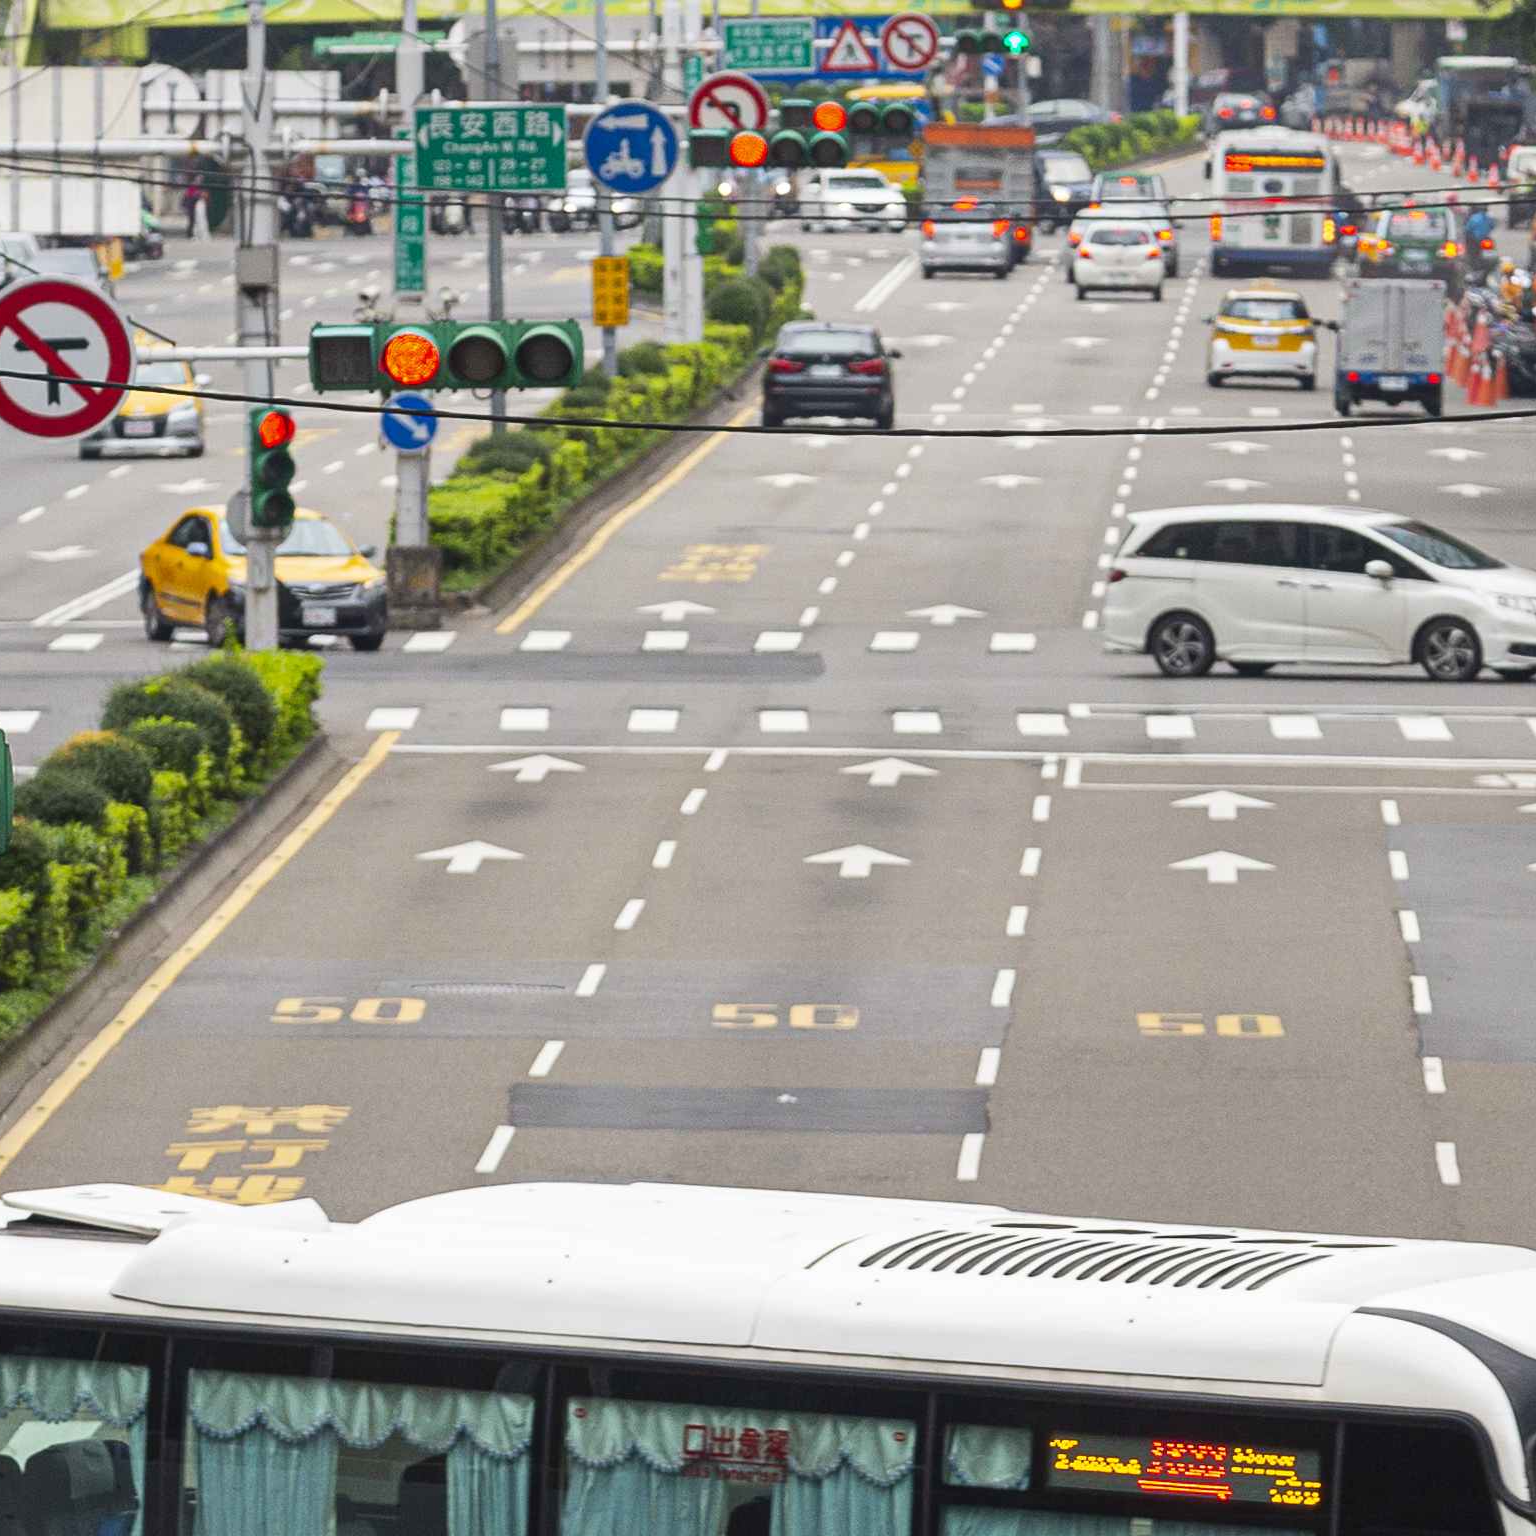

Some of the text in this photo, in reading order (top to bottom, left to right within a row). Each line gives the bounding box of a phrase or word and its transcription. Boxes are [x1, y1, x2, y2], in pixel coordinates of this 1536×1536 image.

[429, 112, 552, 139] 長安西路
[269, 996, 428, 1026] 50
[710, 1002, 861, 1030] 50
[1135, 1011, 1286, 1039] 50
